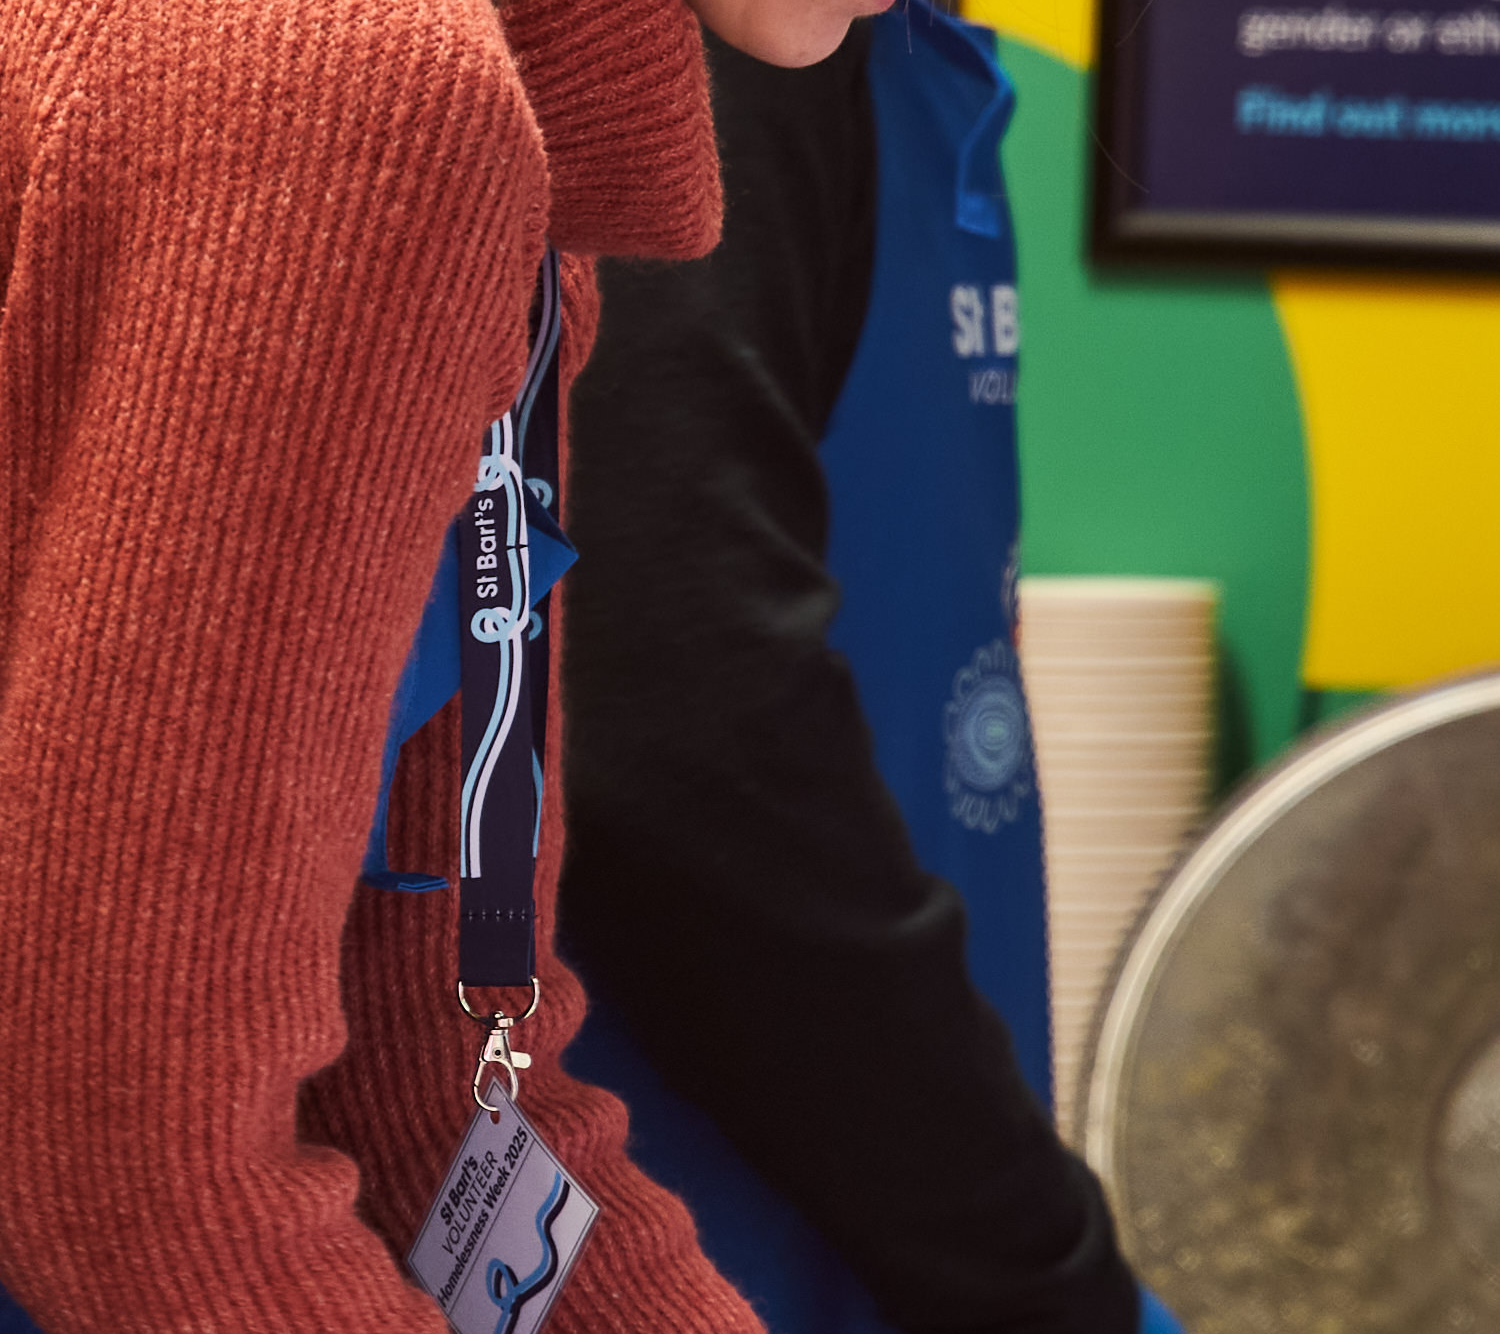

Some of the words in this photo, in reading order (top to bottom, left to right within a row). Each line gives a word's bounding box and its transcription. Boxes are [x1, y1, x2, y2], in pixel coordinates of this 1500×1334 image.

[1237, 89, 1332, 136] Find
[1337, 93, 1408, 139] out
[951, 284, 985, 358] St
[474, 498, 498, 571] Bart's
[476, 575, 499, 599] St
[436, 1208, 490, 1309] Homelessness
[484, 1164, 511, 1211] Week
[504, 1125, 529, 1169] 2025
[439, 1202, 454, 1227] St
[447, 1154, 479, 1210] Bart's
[441, 1150, 499, 1256] VOLUNTEER
